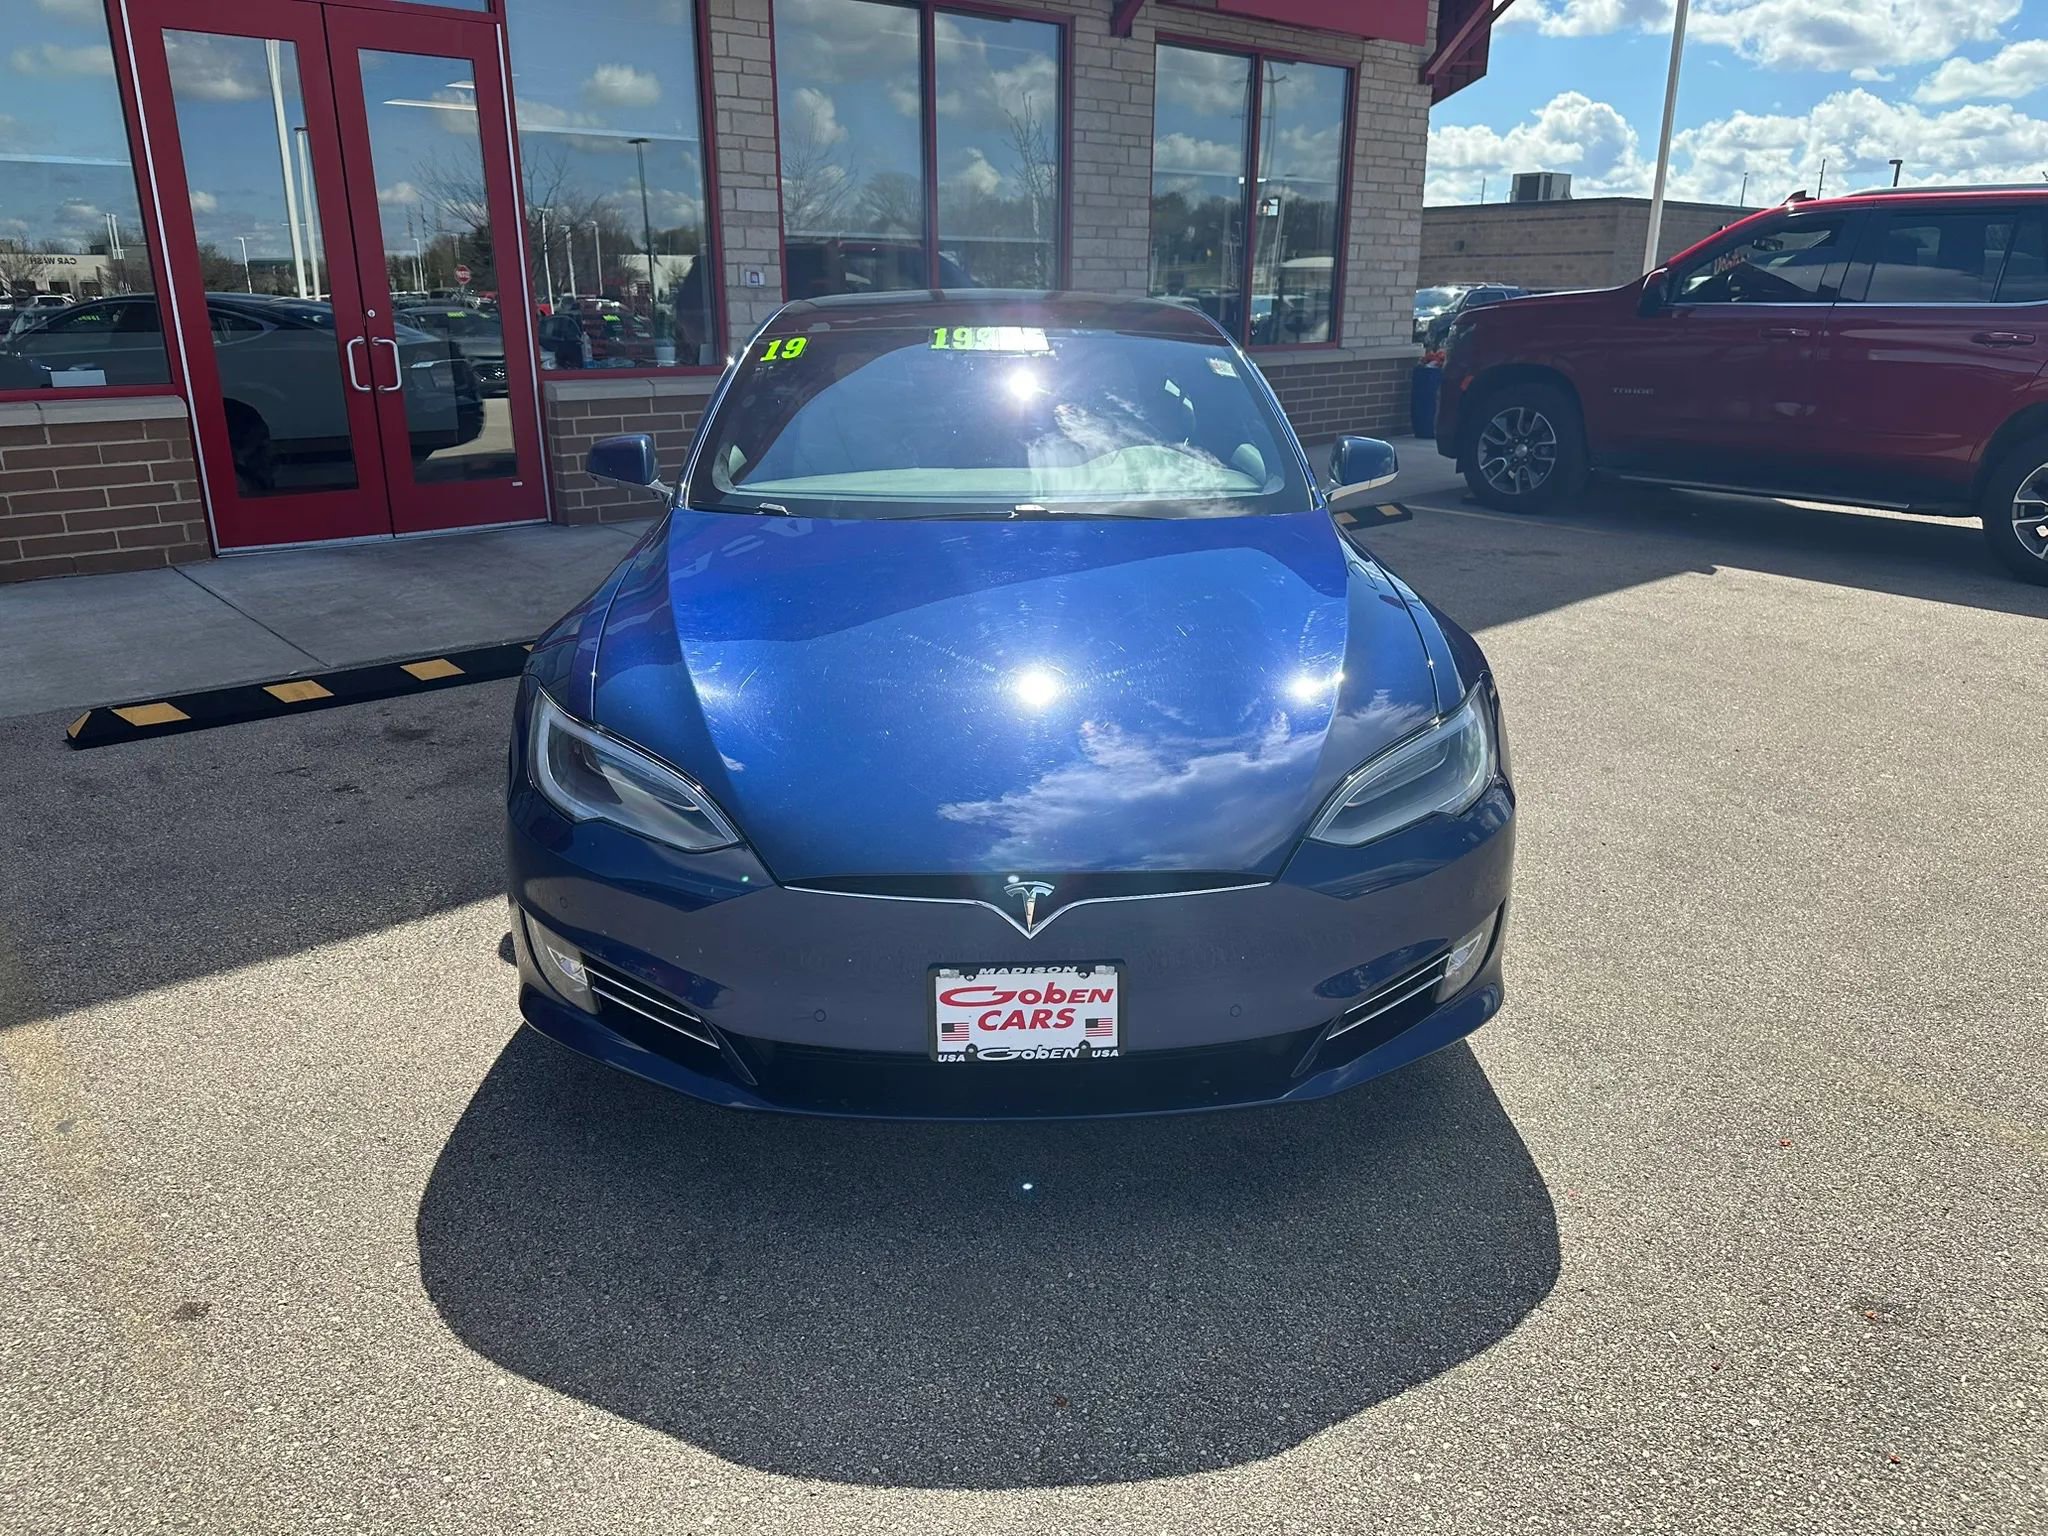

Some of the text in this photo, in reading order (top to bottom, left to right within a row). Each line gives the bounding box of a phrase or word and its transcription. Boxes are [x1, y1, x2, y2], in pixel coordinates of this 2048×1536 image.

[760, 336, 807, 362] 19
[978, 966, 1078, 975] MADISON
[977, 1008, 1076, 1031] CARS
[938, 1053, 966, 1063] USA
[1091, 1049, 1119, 1059] USA
